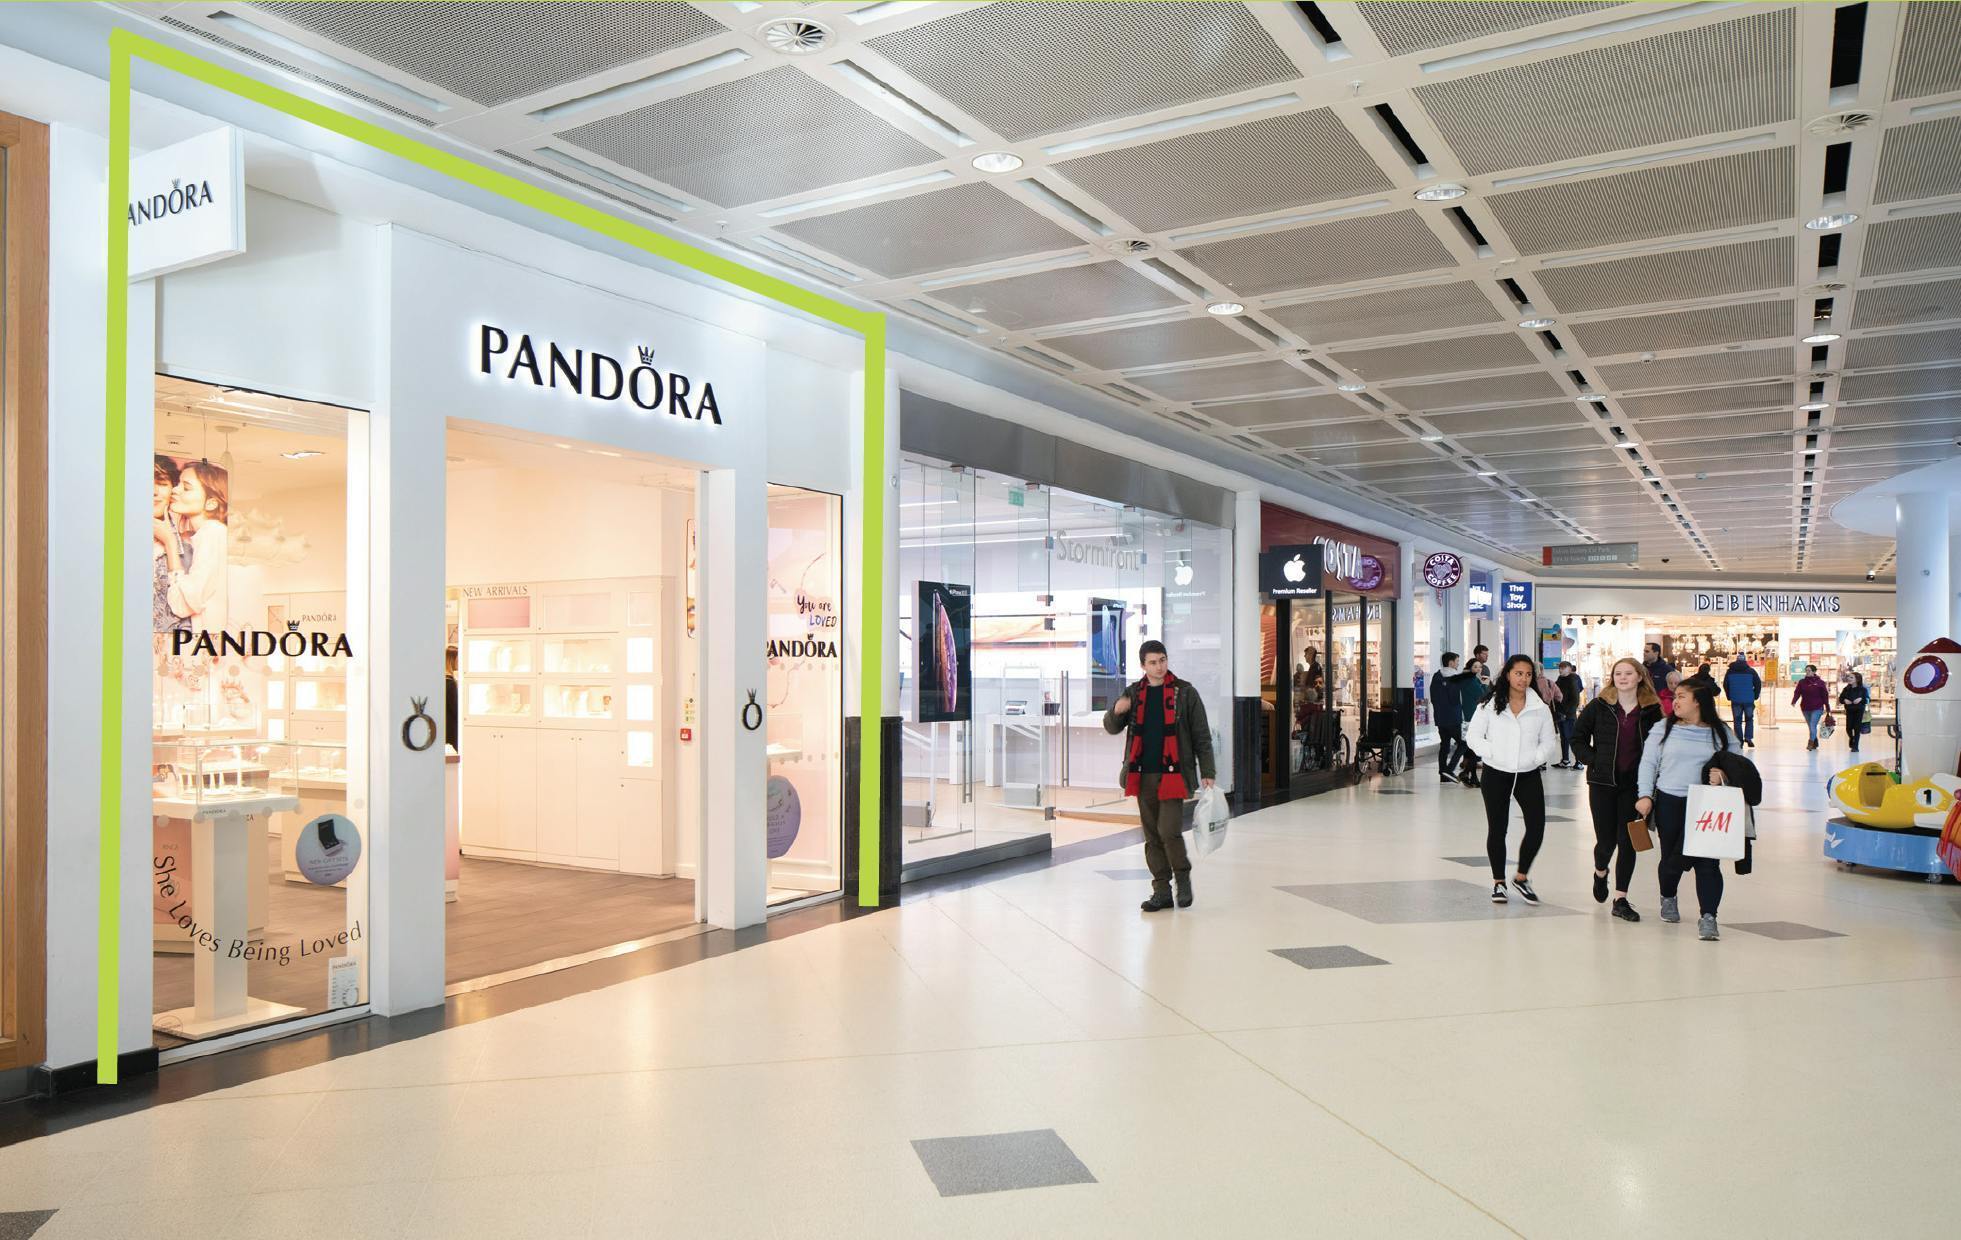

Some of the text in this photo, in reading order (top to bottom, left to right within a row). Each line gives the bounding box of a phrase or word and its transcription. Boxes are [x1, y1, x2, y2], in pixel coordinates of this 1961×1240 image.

[127, 178, 214, 226] ANDORA
[481, 324, 723, 426] PANDORA
[1056, 529, 1140, 571] Stormfront
[1313, 536, 1364, 581] OSTA
[1429, 554, 1455, 566] COSTA
[1427, 573, 1458, 587] COFFEE
[463, 585, 528, 598] NEW ARRIVALS
[1510, 593, 1524, 603] Toy
[1506, 601, 1527, 610] Shop
[1694, 594, 1841, 613] DEBENHAMS
[302, 612, 338, 623] PANDORA
[809, 614, 838, 628] LOVED
[172, 619, 354, 658] PANDORA
[766, 633, 838, 658] ANDORA
[1923, 789, 1932, 806] 1
[1695, 810, 1733, 834] H&M
[153, 855, 362, 966] She Loves Being Loved
